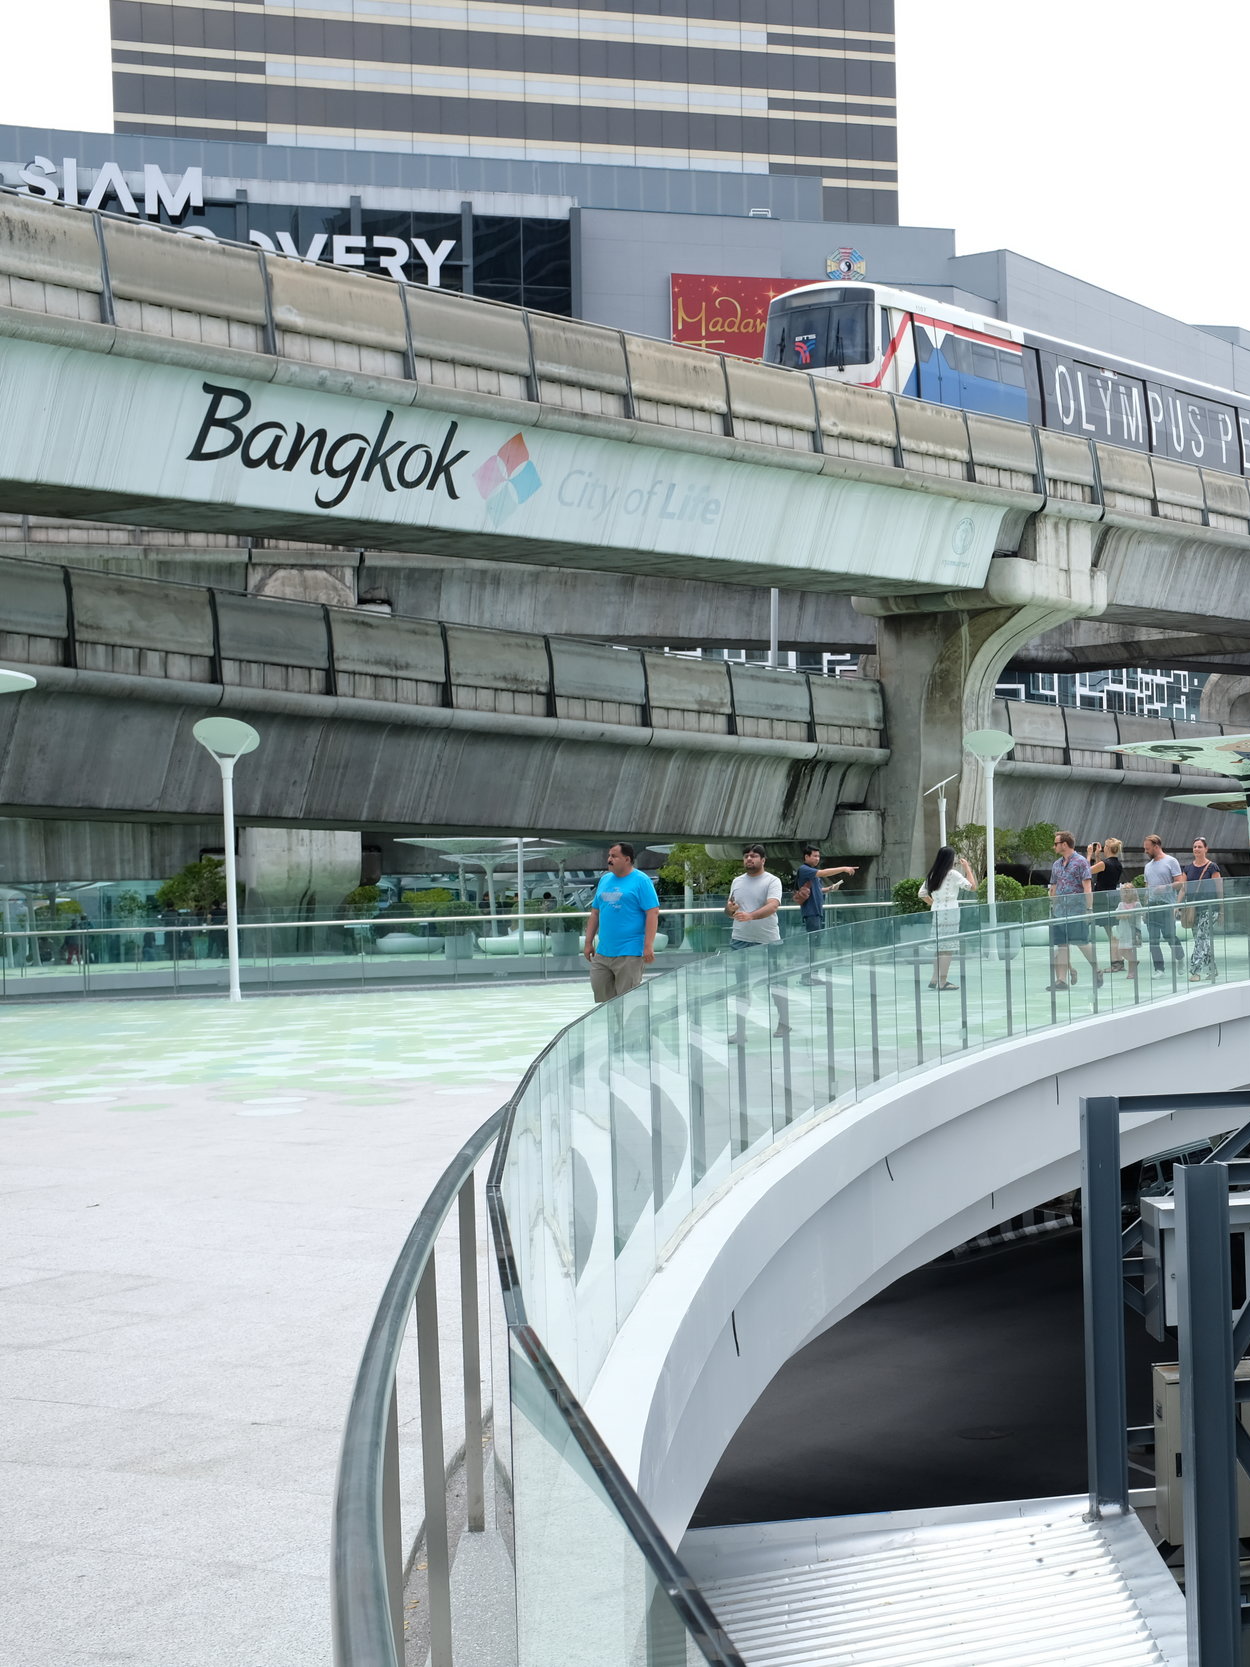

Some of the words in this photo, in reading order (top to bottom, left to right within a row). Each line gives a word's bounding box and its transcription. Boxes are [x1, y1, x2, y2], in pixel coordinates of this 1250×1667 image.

[16, 155, 204, 216] SIAM
[186, 381, 470, 509] Bangkok
[1055, 364, 1205, 458] OLYMPUS
[558, 469, 620, 522] City
[623, 479, 663, 516] of
